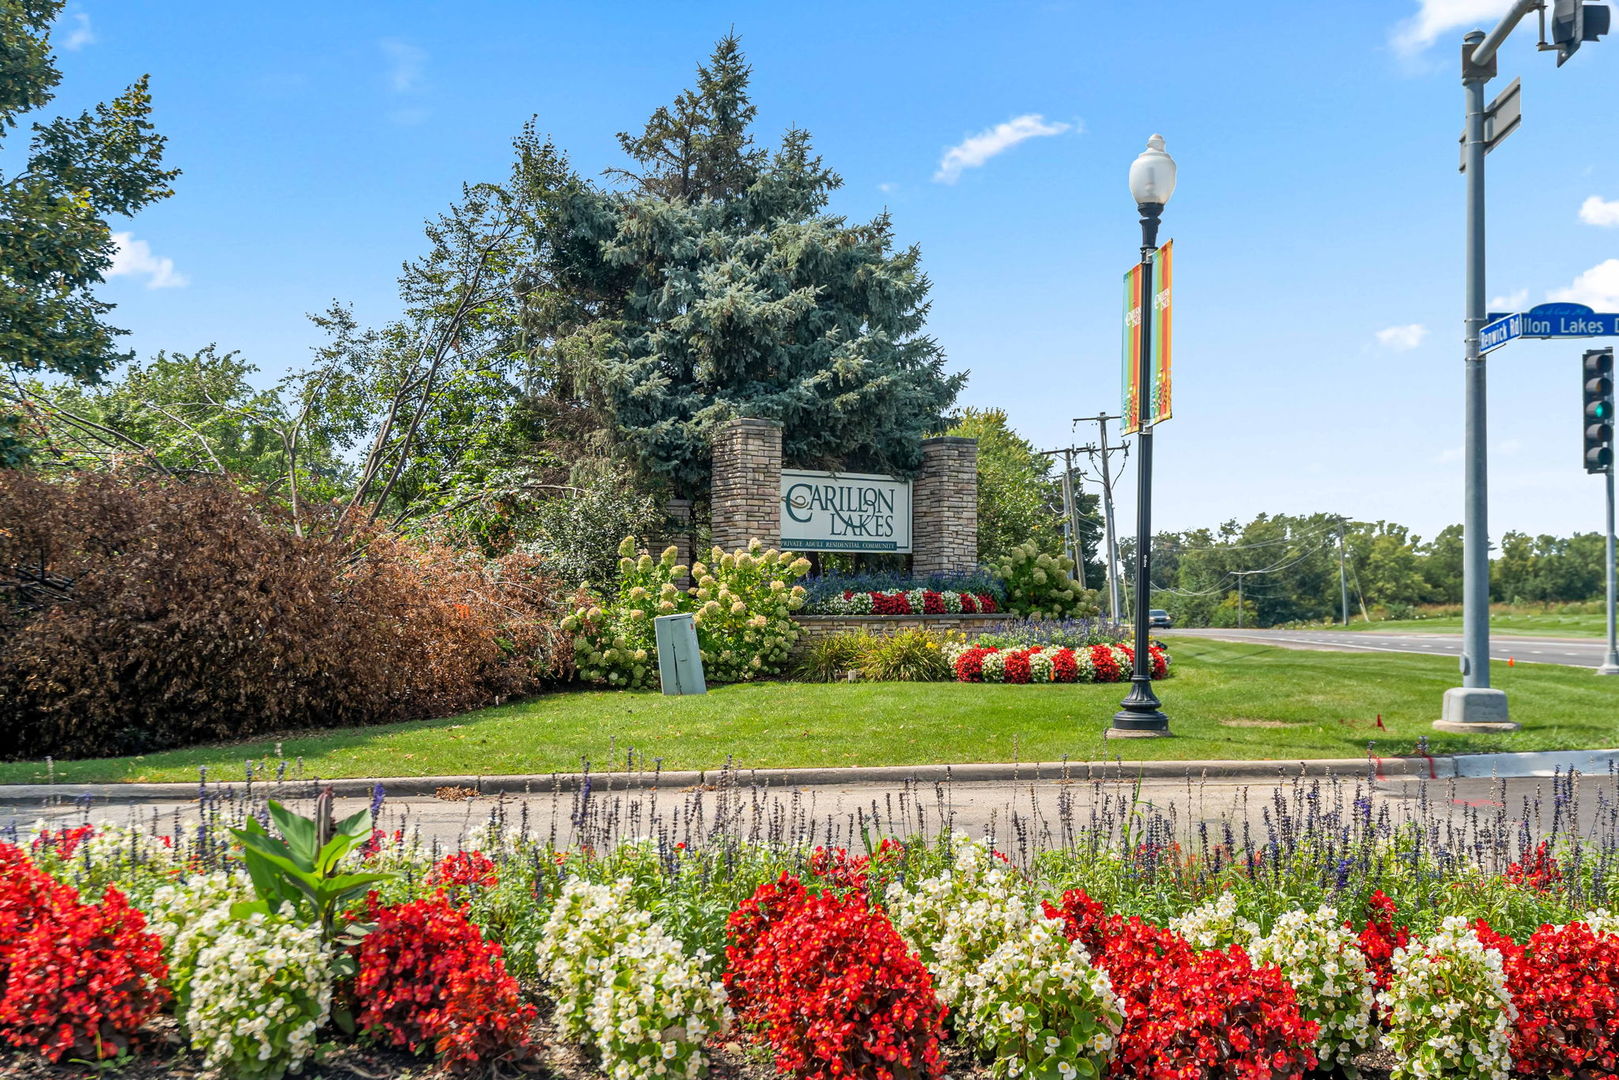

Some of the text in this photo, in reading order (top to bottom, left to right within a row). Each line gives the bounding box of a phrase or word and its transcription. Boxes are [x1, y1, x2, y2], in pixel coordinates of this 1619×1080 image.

[1509, 316, 1520, 338] Rd
[1561, 317, 1604, 333] Lakes
[786, 483, 895, 523] CARILLON
[830, 513, 894, 537] LAKES
[825, 541, 860, 549] RESIDENTIAL
[862, 542, 895, 550] COMMUNITY
